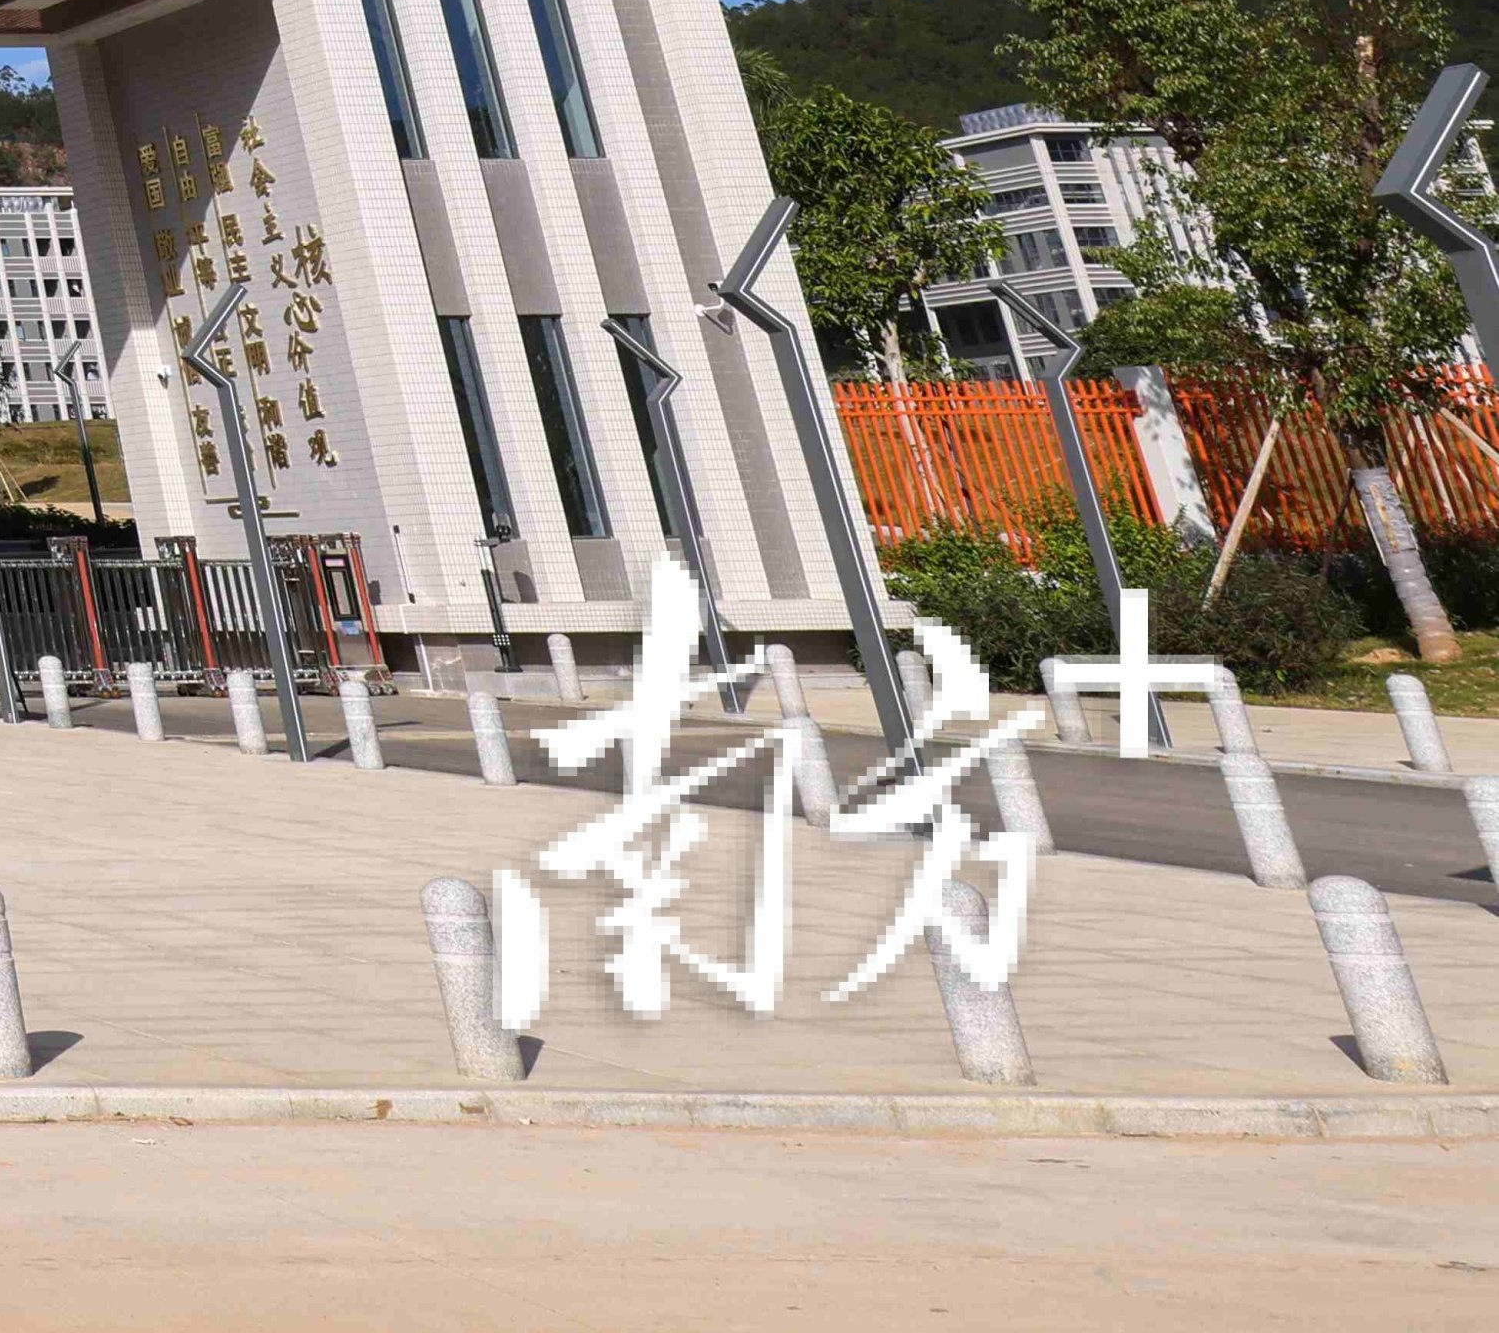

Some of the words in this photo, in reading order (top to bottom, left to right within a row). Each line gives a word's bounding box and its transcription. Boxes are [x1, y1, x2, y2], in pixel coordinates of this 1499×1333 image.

[239, 115, 298, 289] 社会主义
[284, 223, 340, 468] 核心价值观
